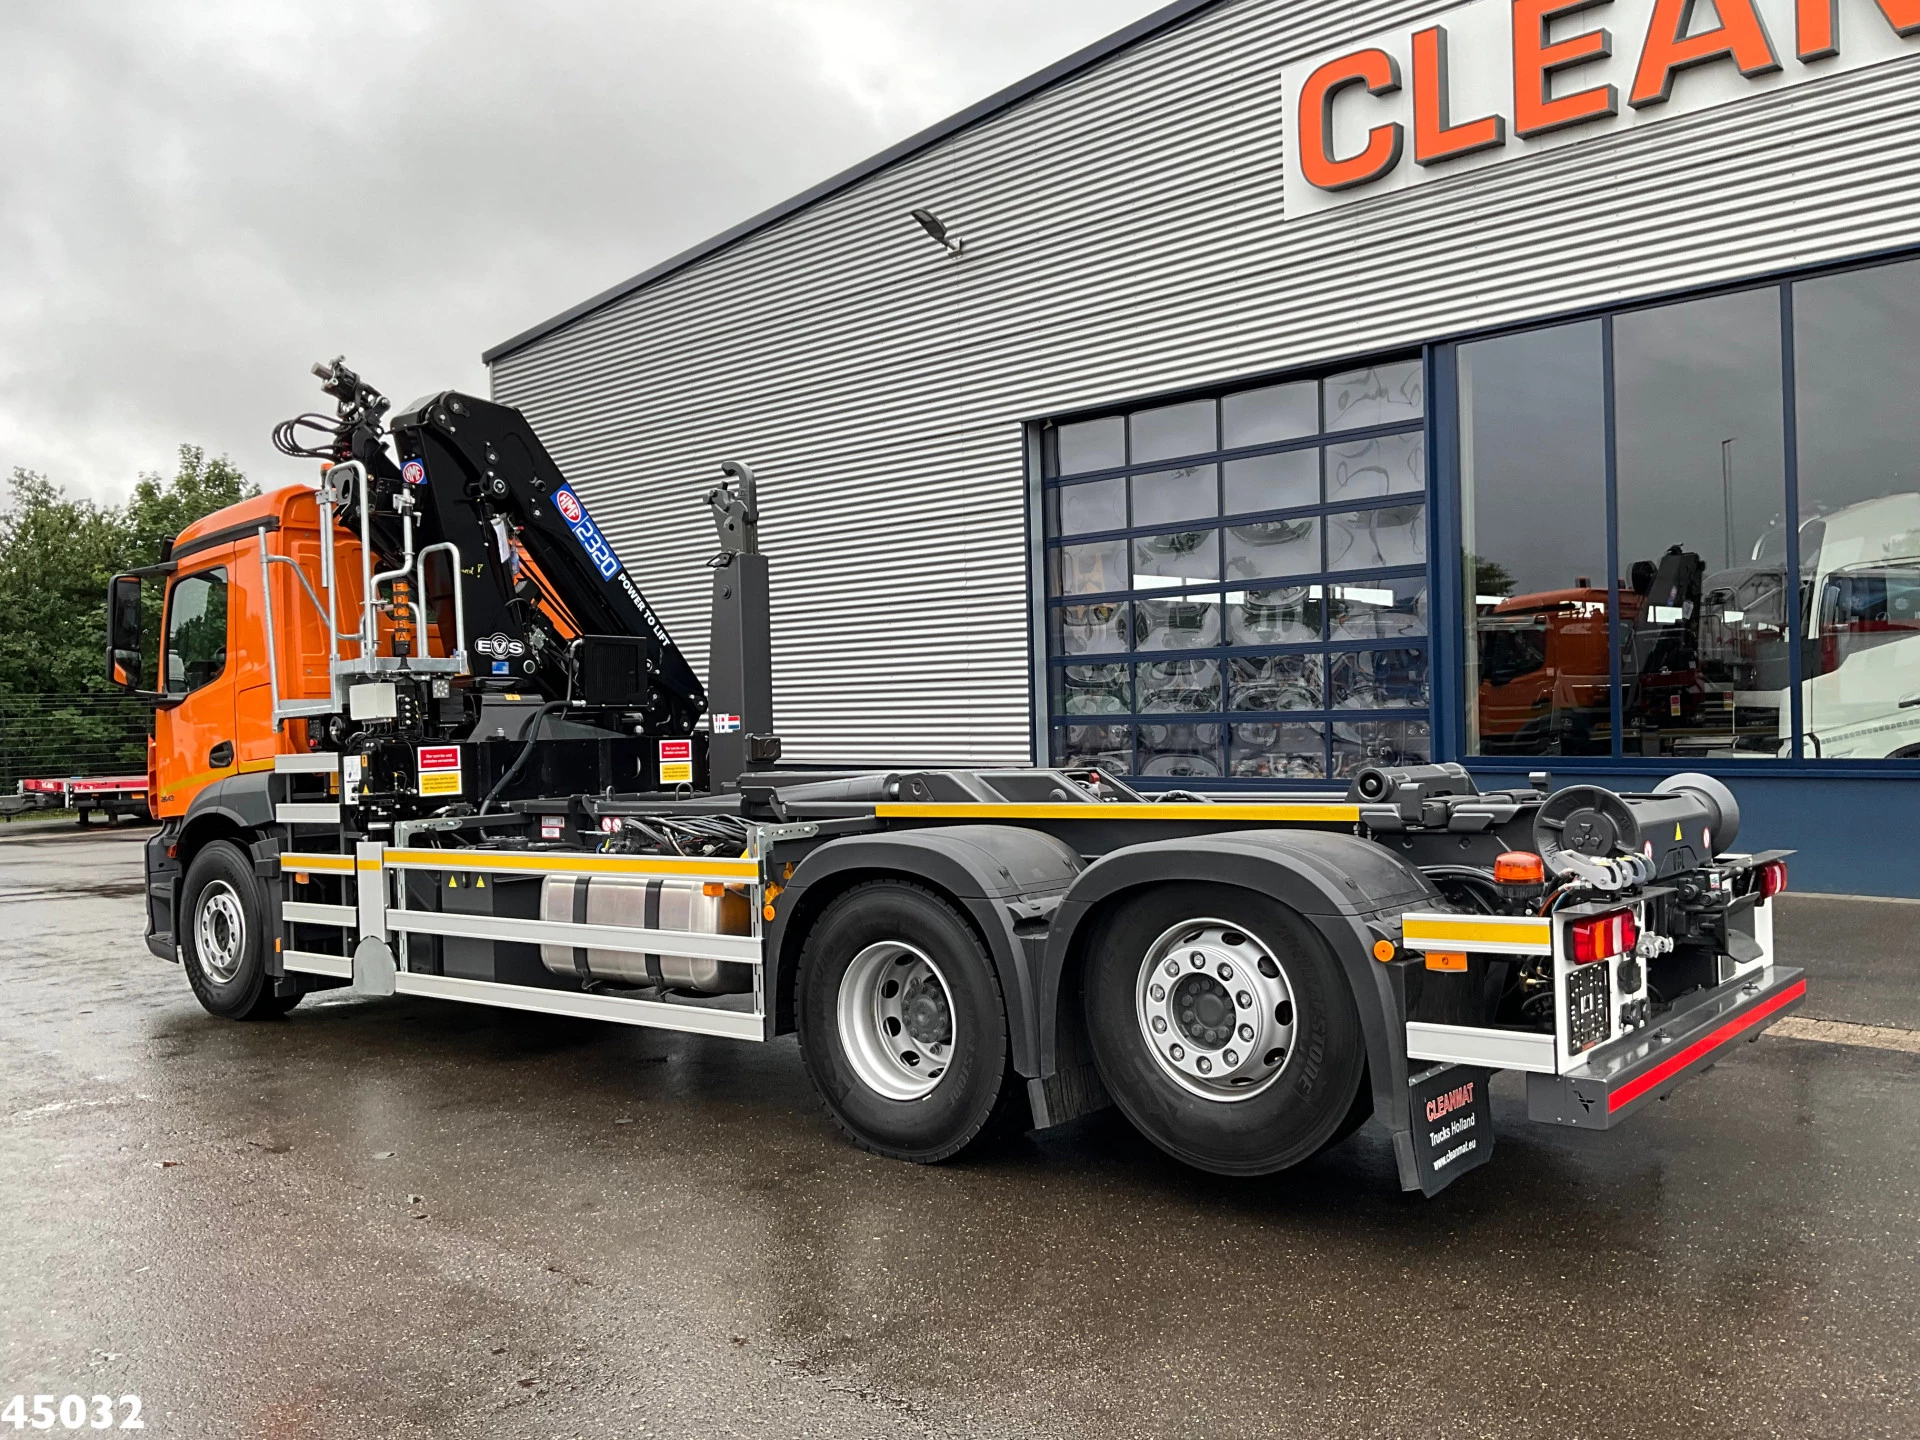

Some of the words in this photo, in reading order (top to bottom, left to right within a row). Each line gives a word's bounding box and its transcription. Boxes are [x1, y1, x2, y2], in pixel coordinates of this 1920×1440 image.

[559, 494, 579, 519] HMF
[576, 521, 617, 577] 2320
[618, 573, 646, 611] POWER
[643, 609, 656, 626] TO
[653, 624, 671, 647] LIFT
[1426, 1082, 1474, 1122] CLEANMAT
[1429, 1126, 1451, 1147] Trucks
[1451, 1112, 1475, 1136] Holland
[1432, 1139, 1476, 1171] www.cleanmat.eu
